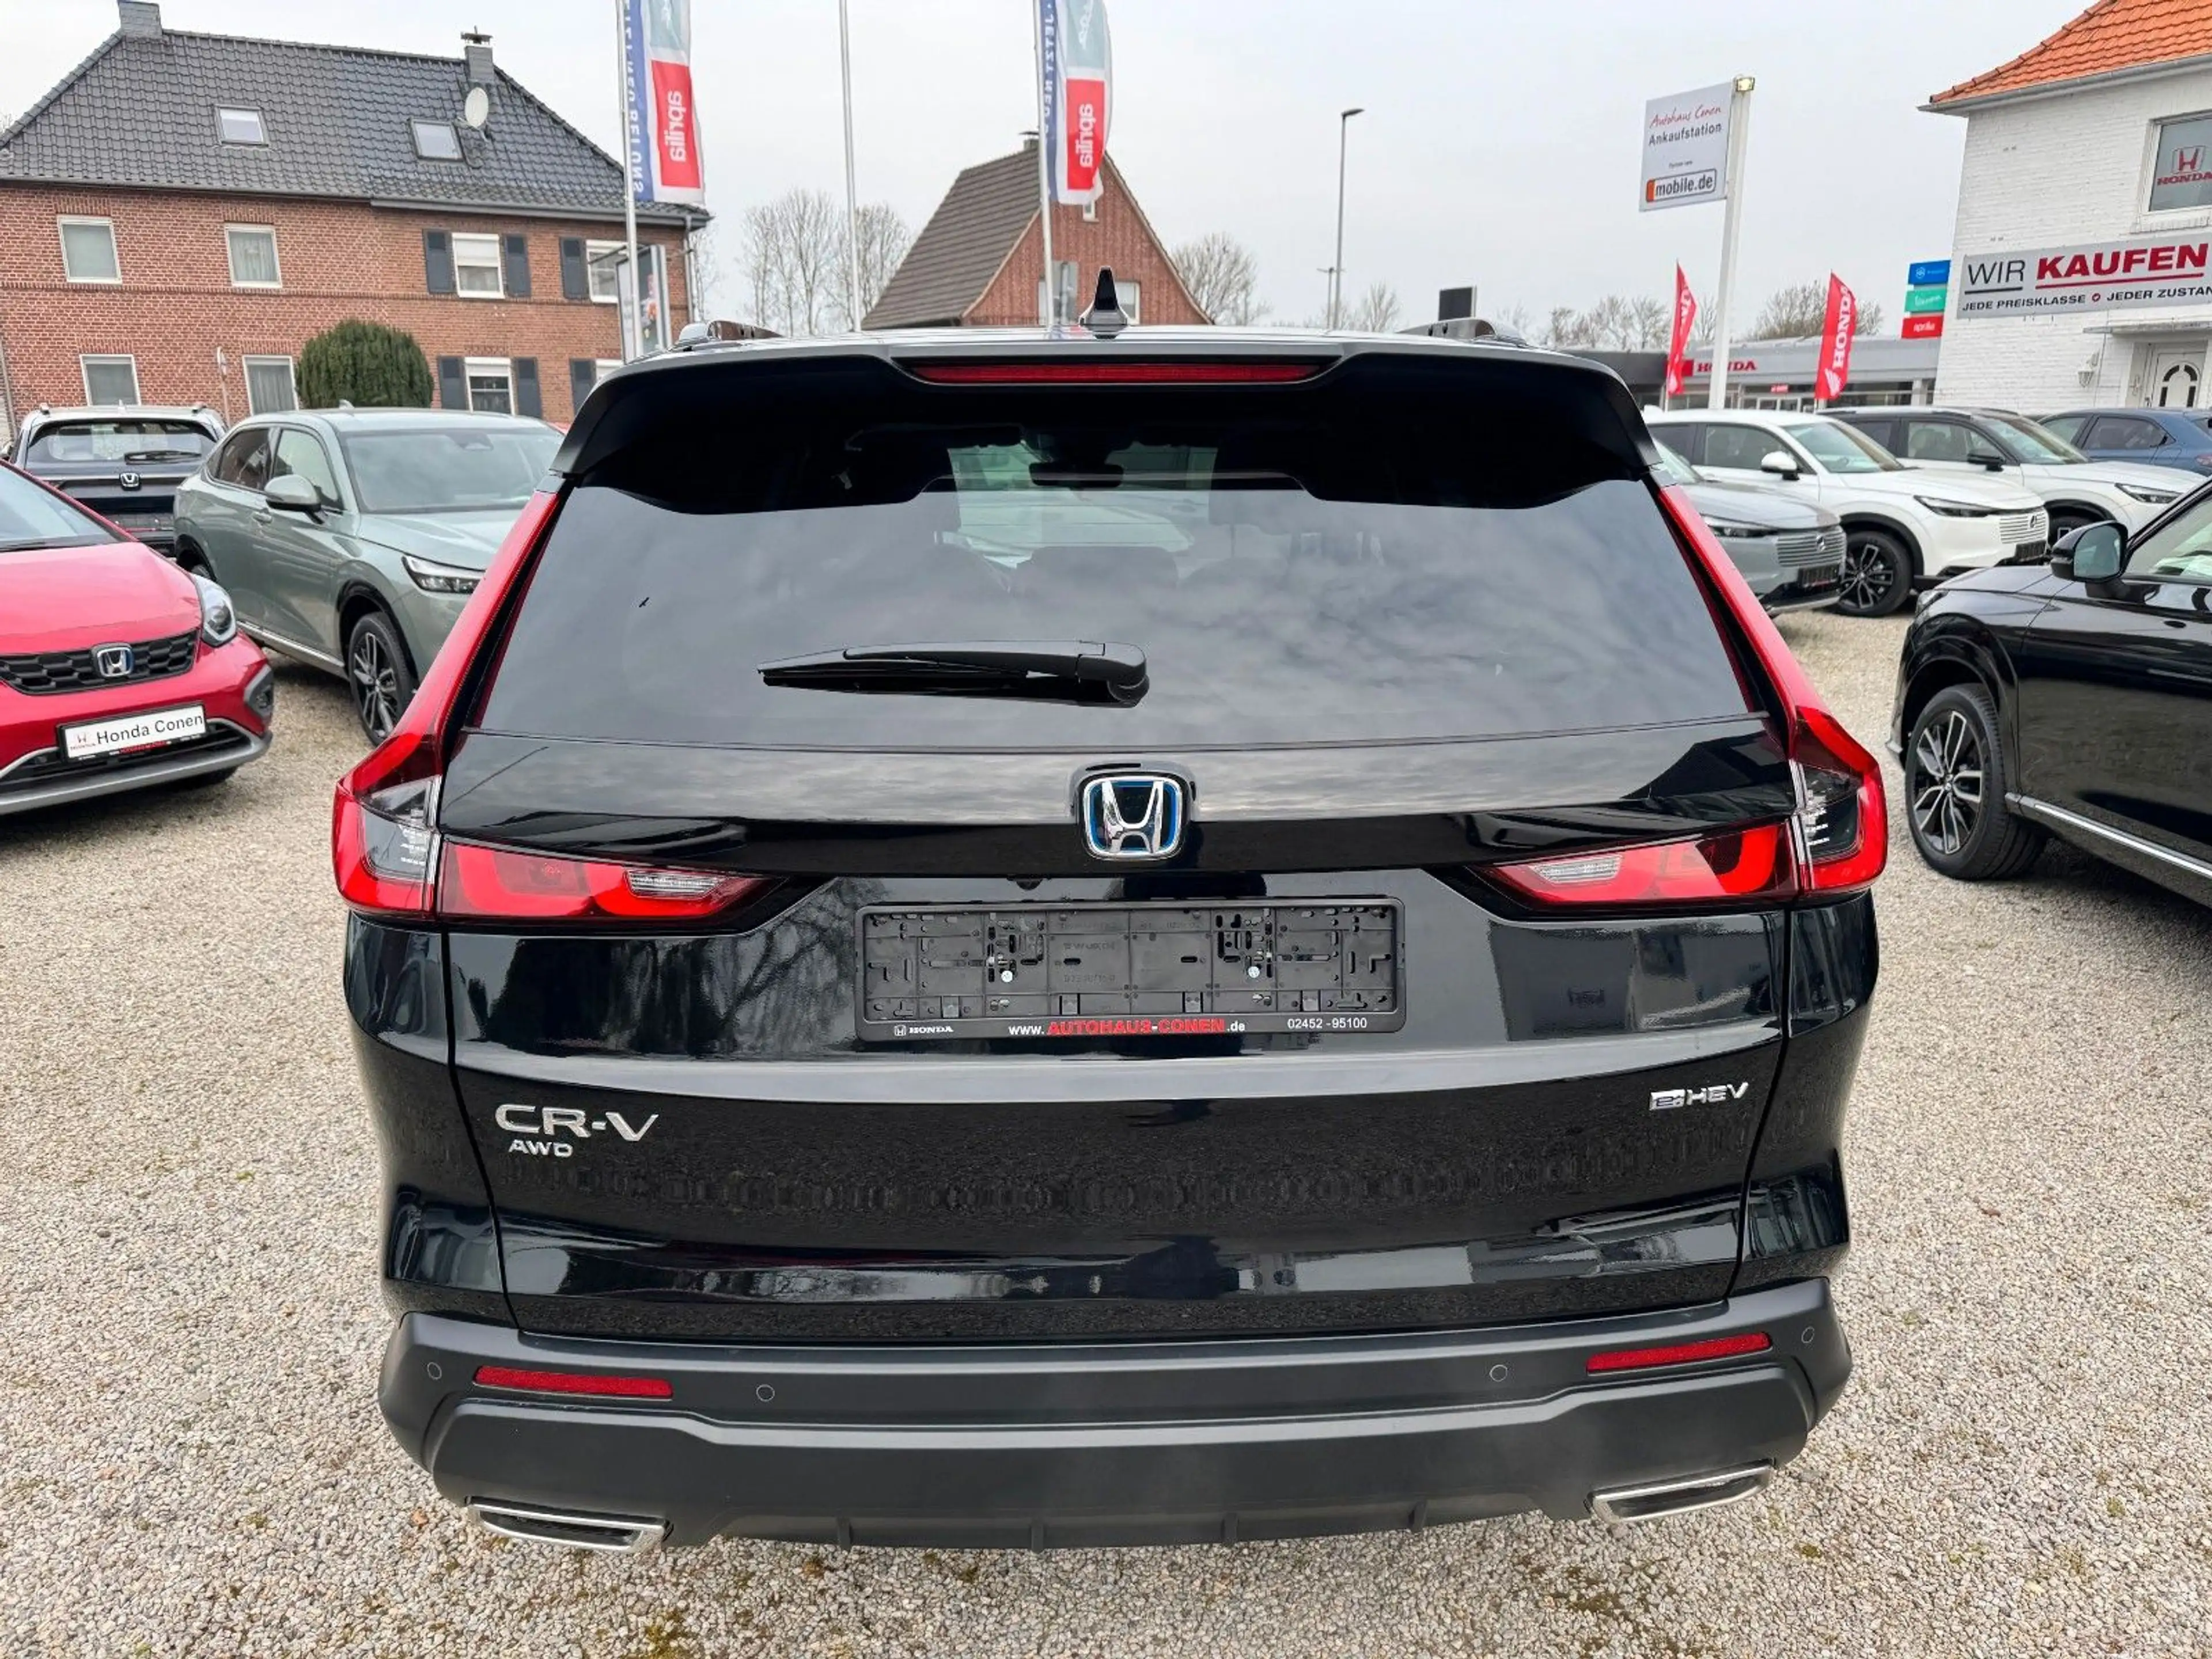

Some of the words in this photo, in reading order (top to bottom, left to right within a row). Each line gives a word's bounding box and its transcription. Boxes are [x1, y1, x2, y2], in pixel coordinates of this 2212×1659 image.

[1650, 107, 1691, 129] Autohaus
[1649, 123, 1722, 146] Ankaufstation
[1656, 174, 1713, 196] mobile.de
[1968, 259, 2025, 286] WIR
[2037, 243, 2209, 281] KAUFEN
[1963, 301, 1994, 311] JEDE
[1997, 294, 2086, 309] PREISKLASSE
[2107, 290, 2153, 301] JEDER
[1698, 361, 1757, 373] HDA
[96, 724, 150, 745] Honda
[154, 715, 203, 733] Conen
[908, 1025, 954, 1034] HONDA
[1287, 1018, 1323, 1029] 02452
[494, 1104, 660, 1142] CR-V
[508, 1138, 574, 1158] AWD
